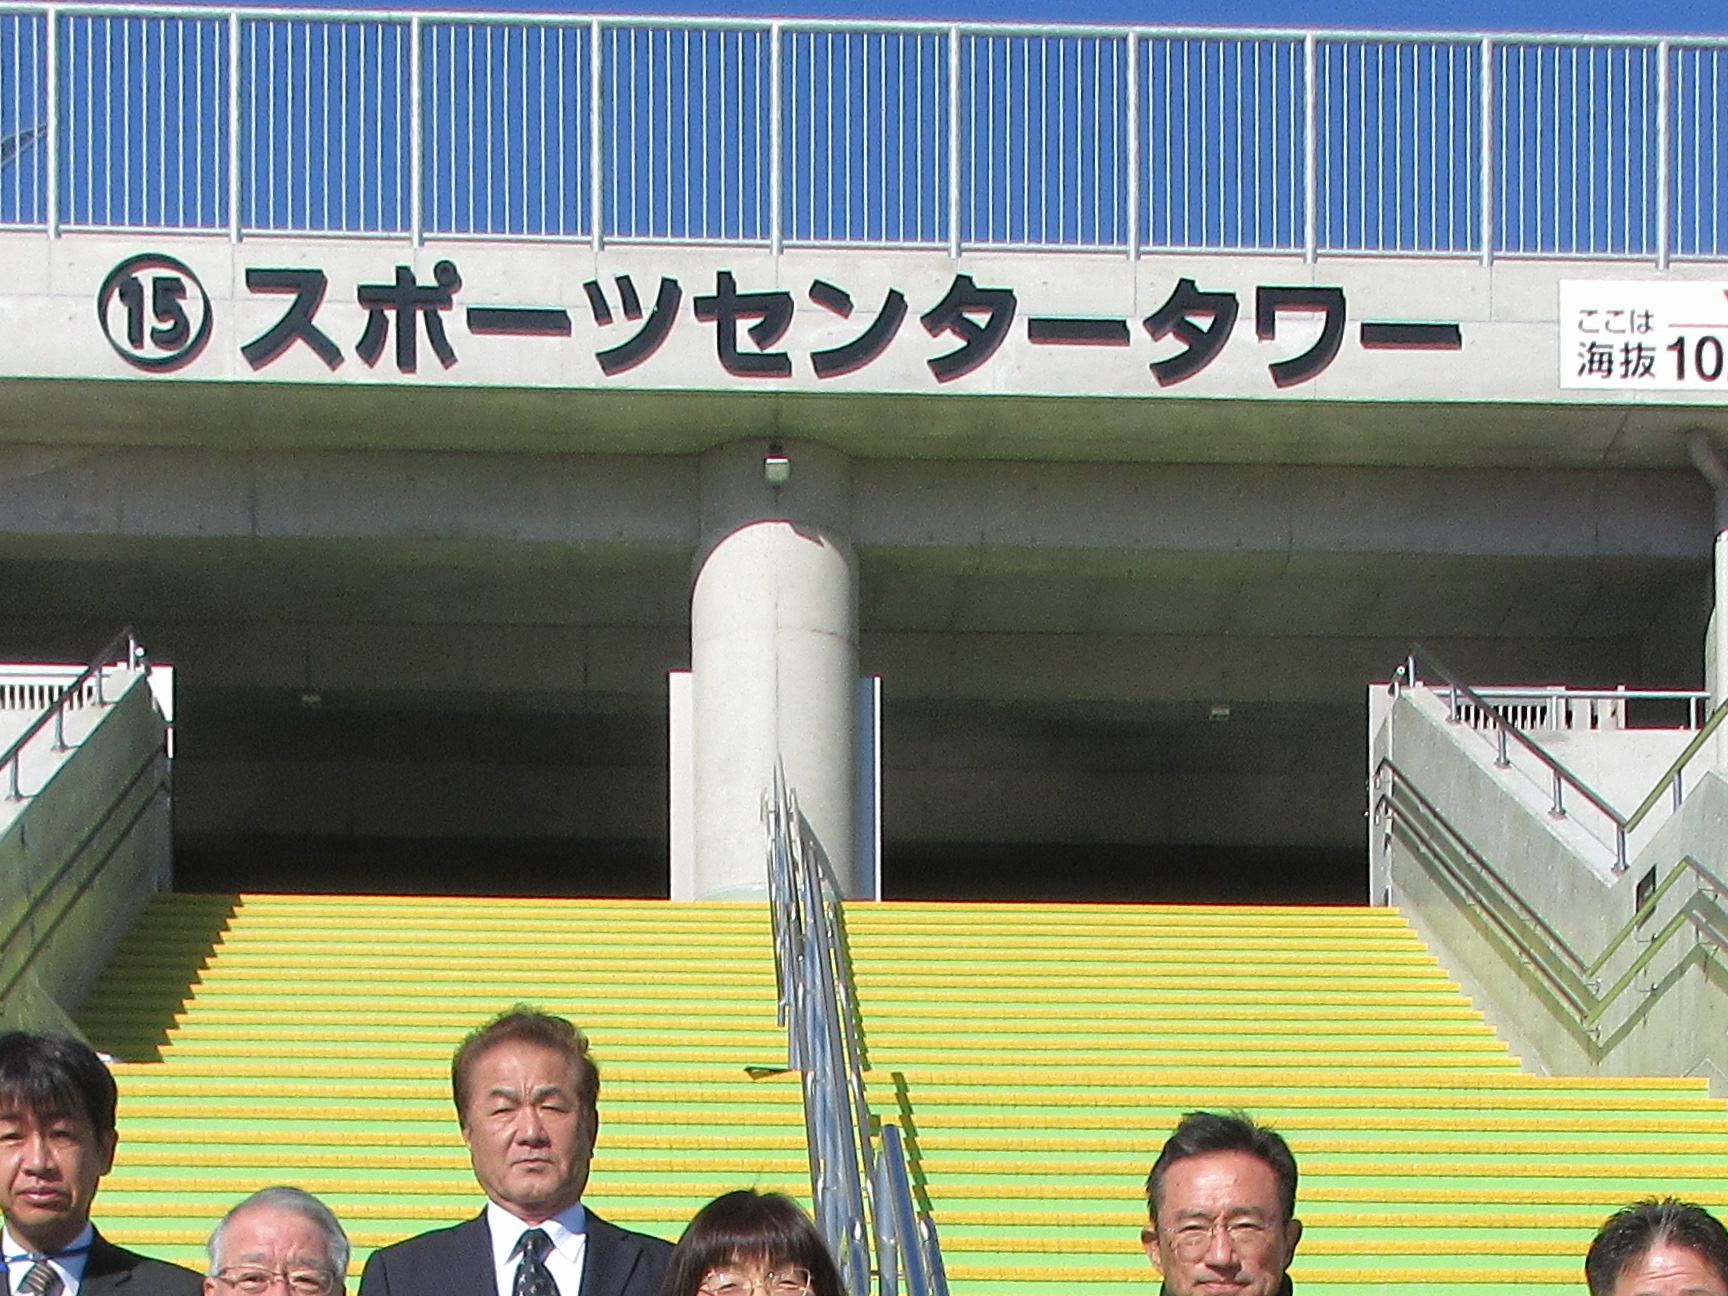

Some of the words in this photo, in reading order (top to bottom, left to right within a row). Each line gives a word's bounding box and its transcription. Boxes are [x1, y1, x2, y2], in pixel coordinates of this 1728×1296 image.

[240, 258, 1463, 389] スポーツセンタータワー
[1577, 309, 1654, 334] ここは
